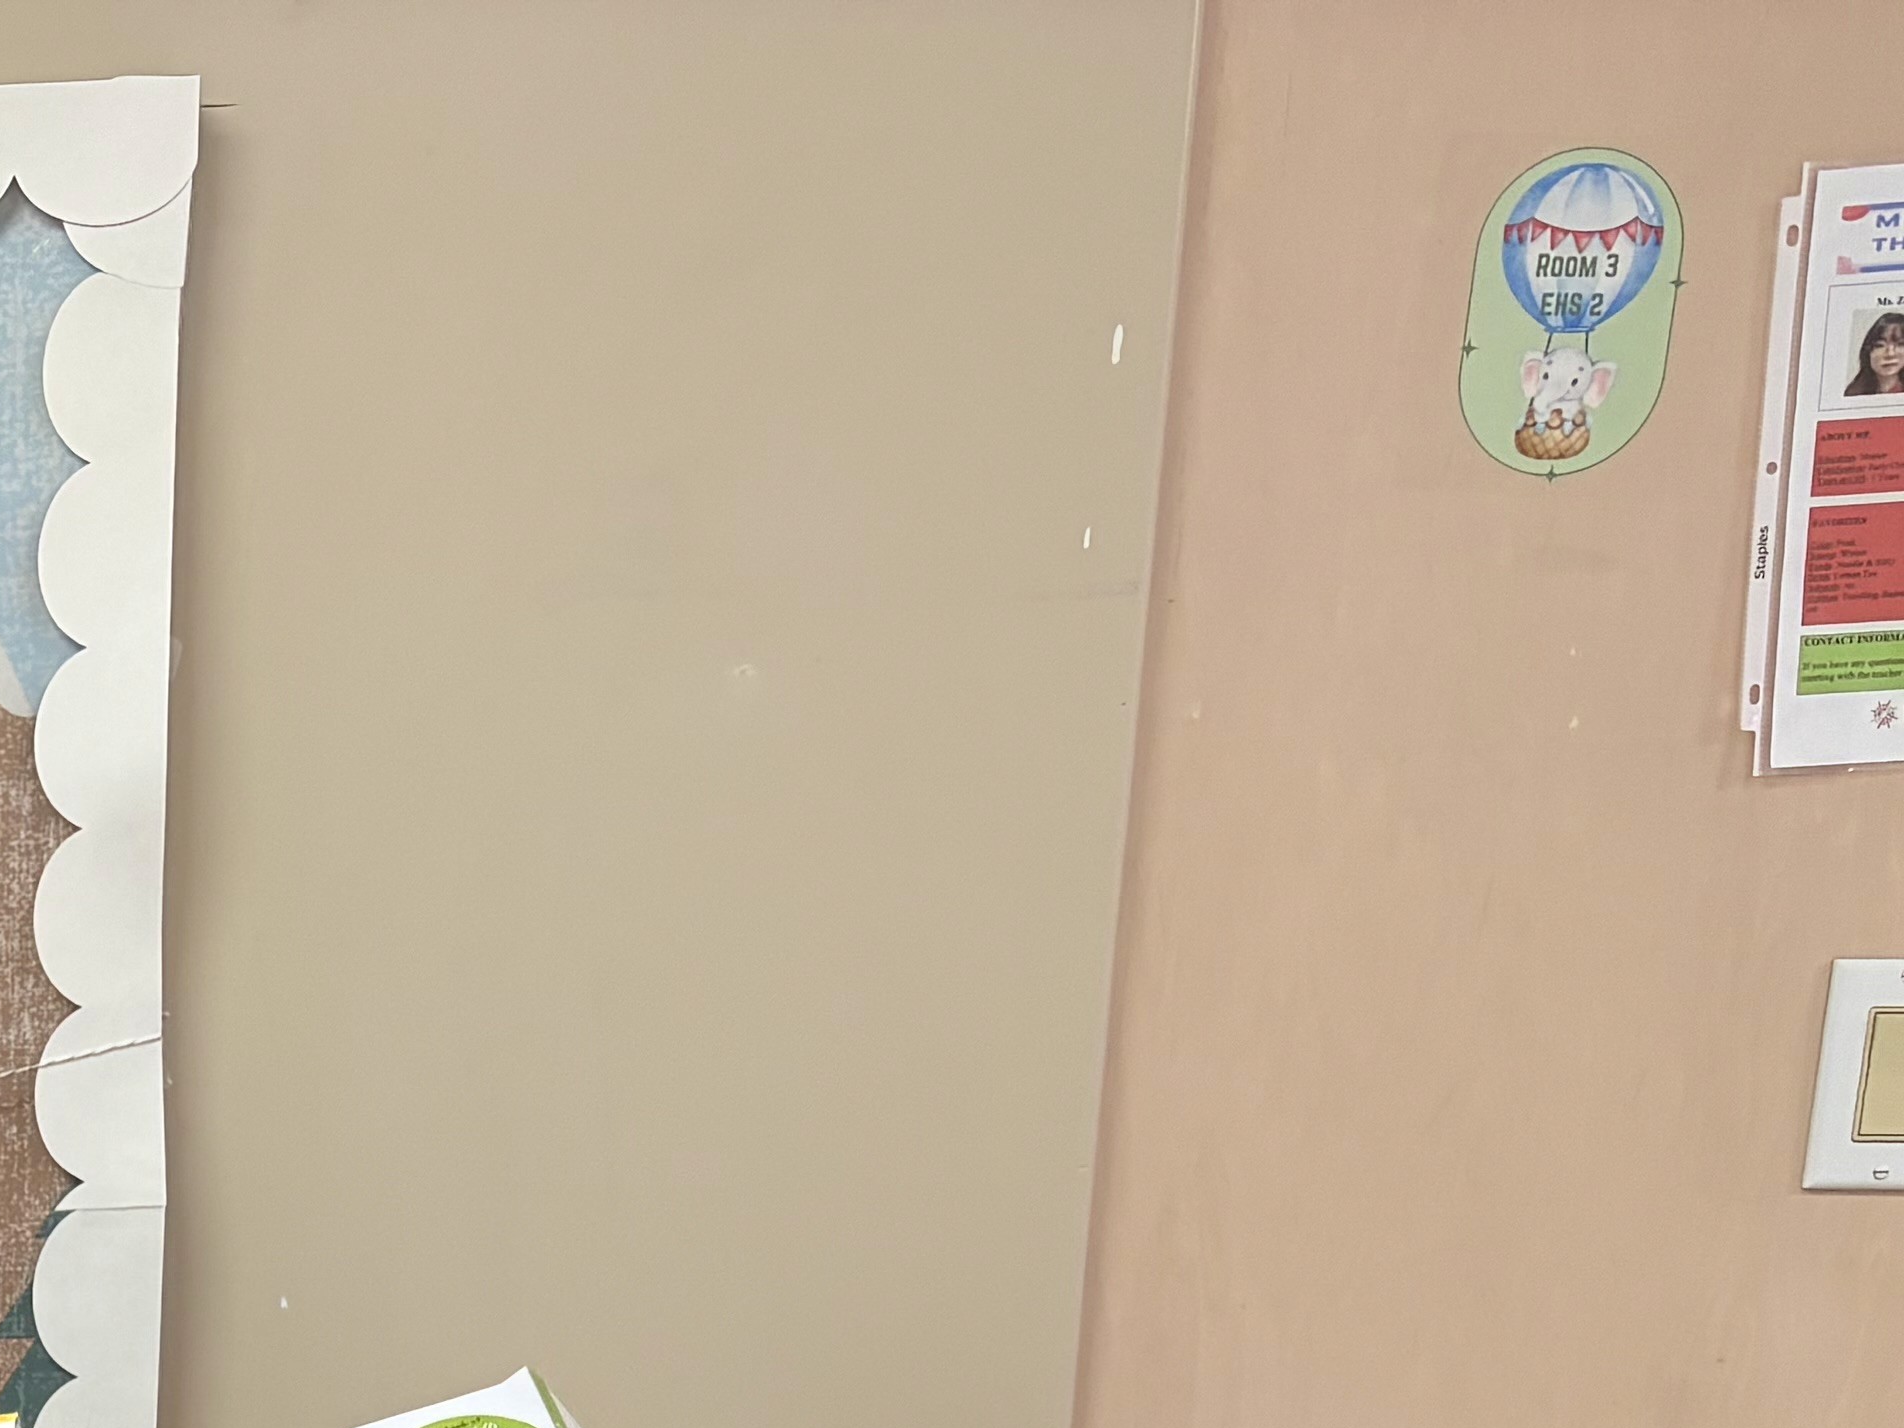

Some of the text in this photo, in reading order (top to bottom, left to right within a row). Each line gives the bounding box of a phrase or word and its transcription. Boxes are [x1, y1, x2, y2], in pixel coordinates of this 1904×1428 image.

[1872, 236, 1904, 252] TH
[1535, 253, 1619, 279] ROOM 3
[1540, 292, 1604, 318] EHS 2
[1754, 525, 1769, 580] Staples
[1804, 636, 1855, 646] CONTACT
